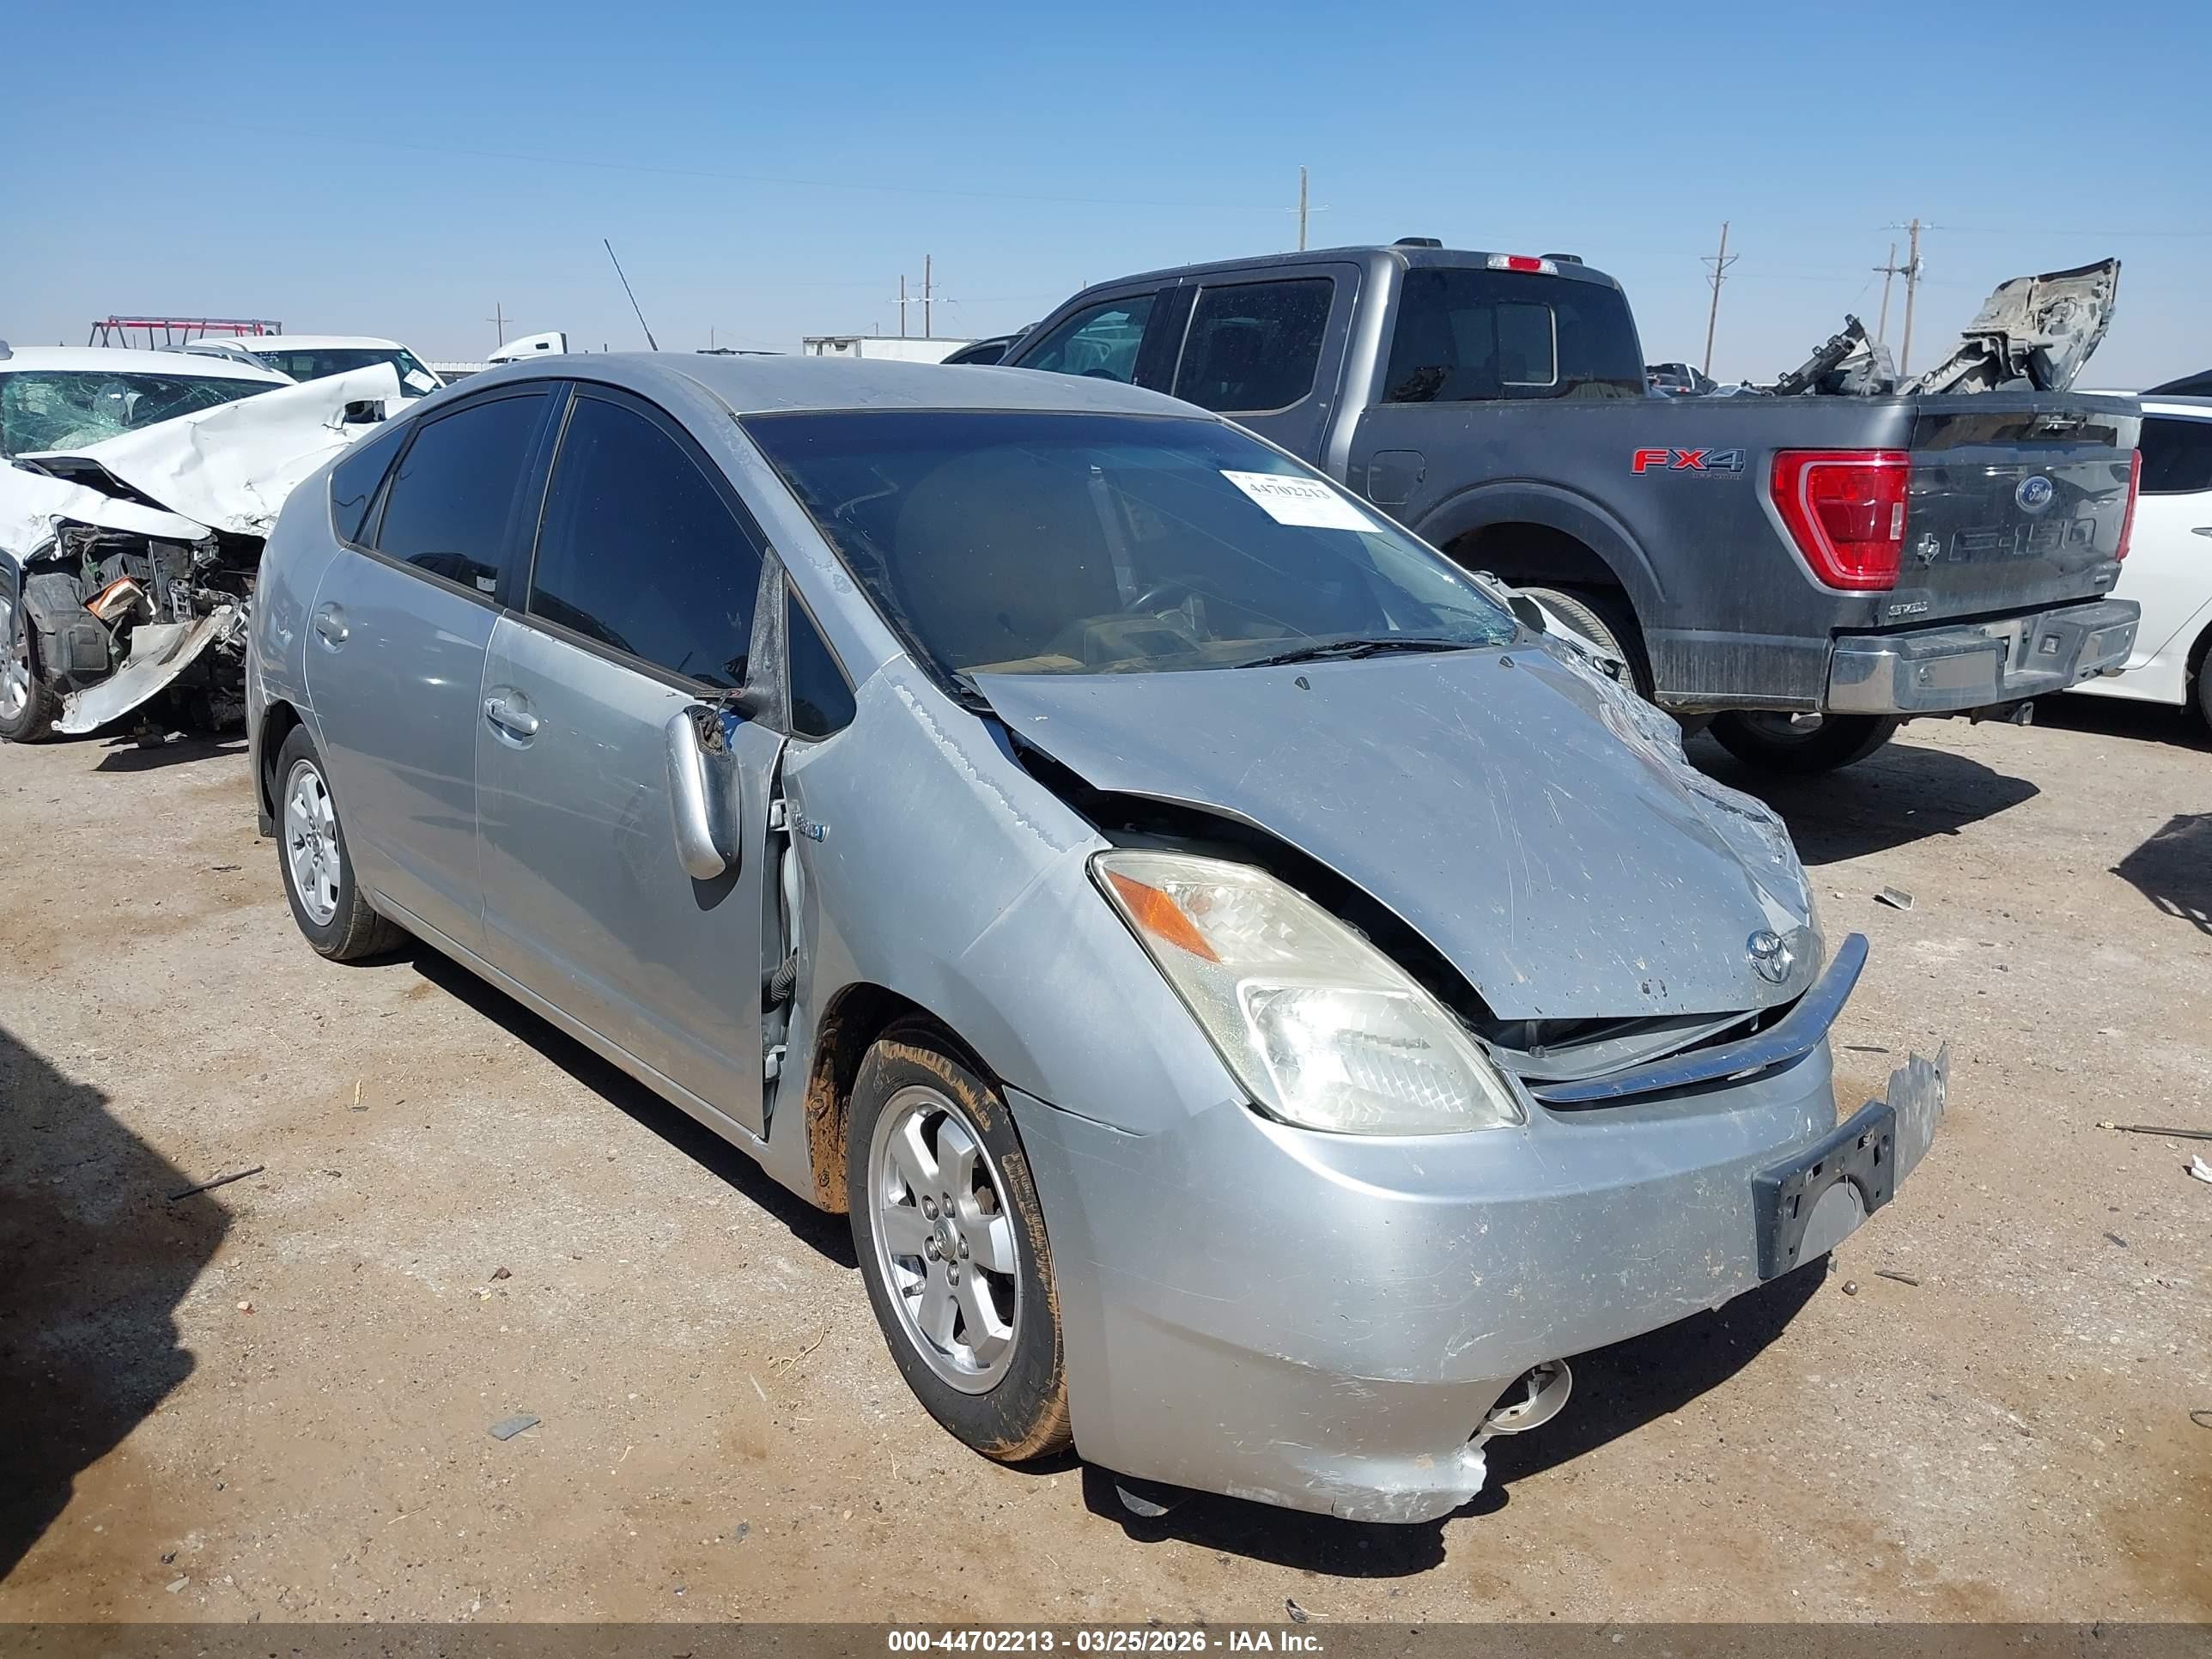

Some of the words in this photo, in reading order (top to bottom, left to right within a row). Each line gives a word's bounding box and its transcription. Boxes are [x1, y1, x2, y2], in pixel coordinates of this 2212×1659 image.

[1630, 447, 1746, 477] FX4
[1249, 483, 1331, 500] 44702213
[1948, 518, 2097, 562] F-150
